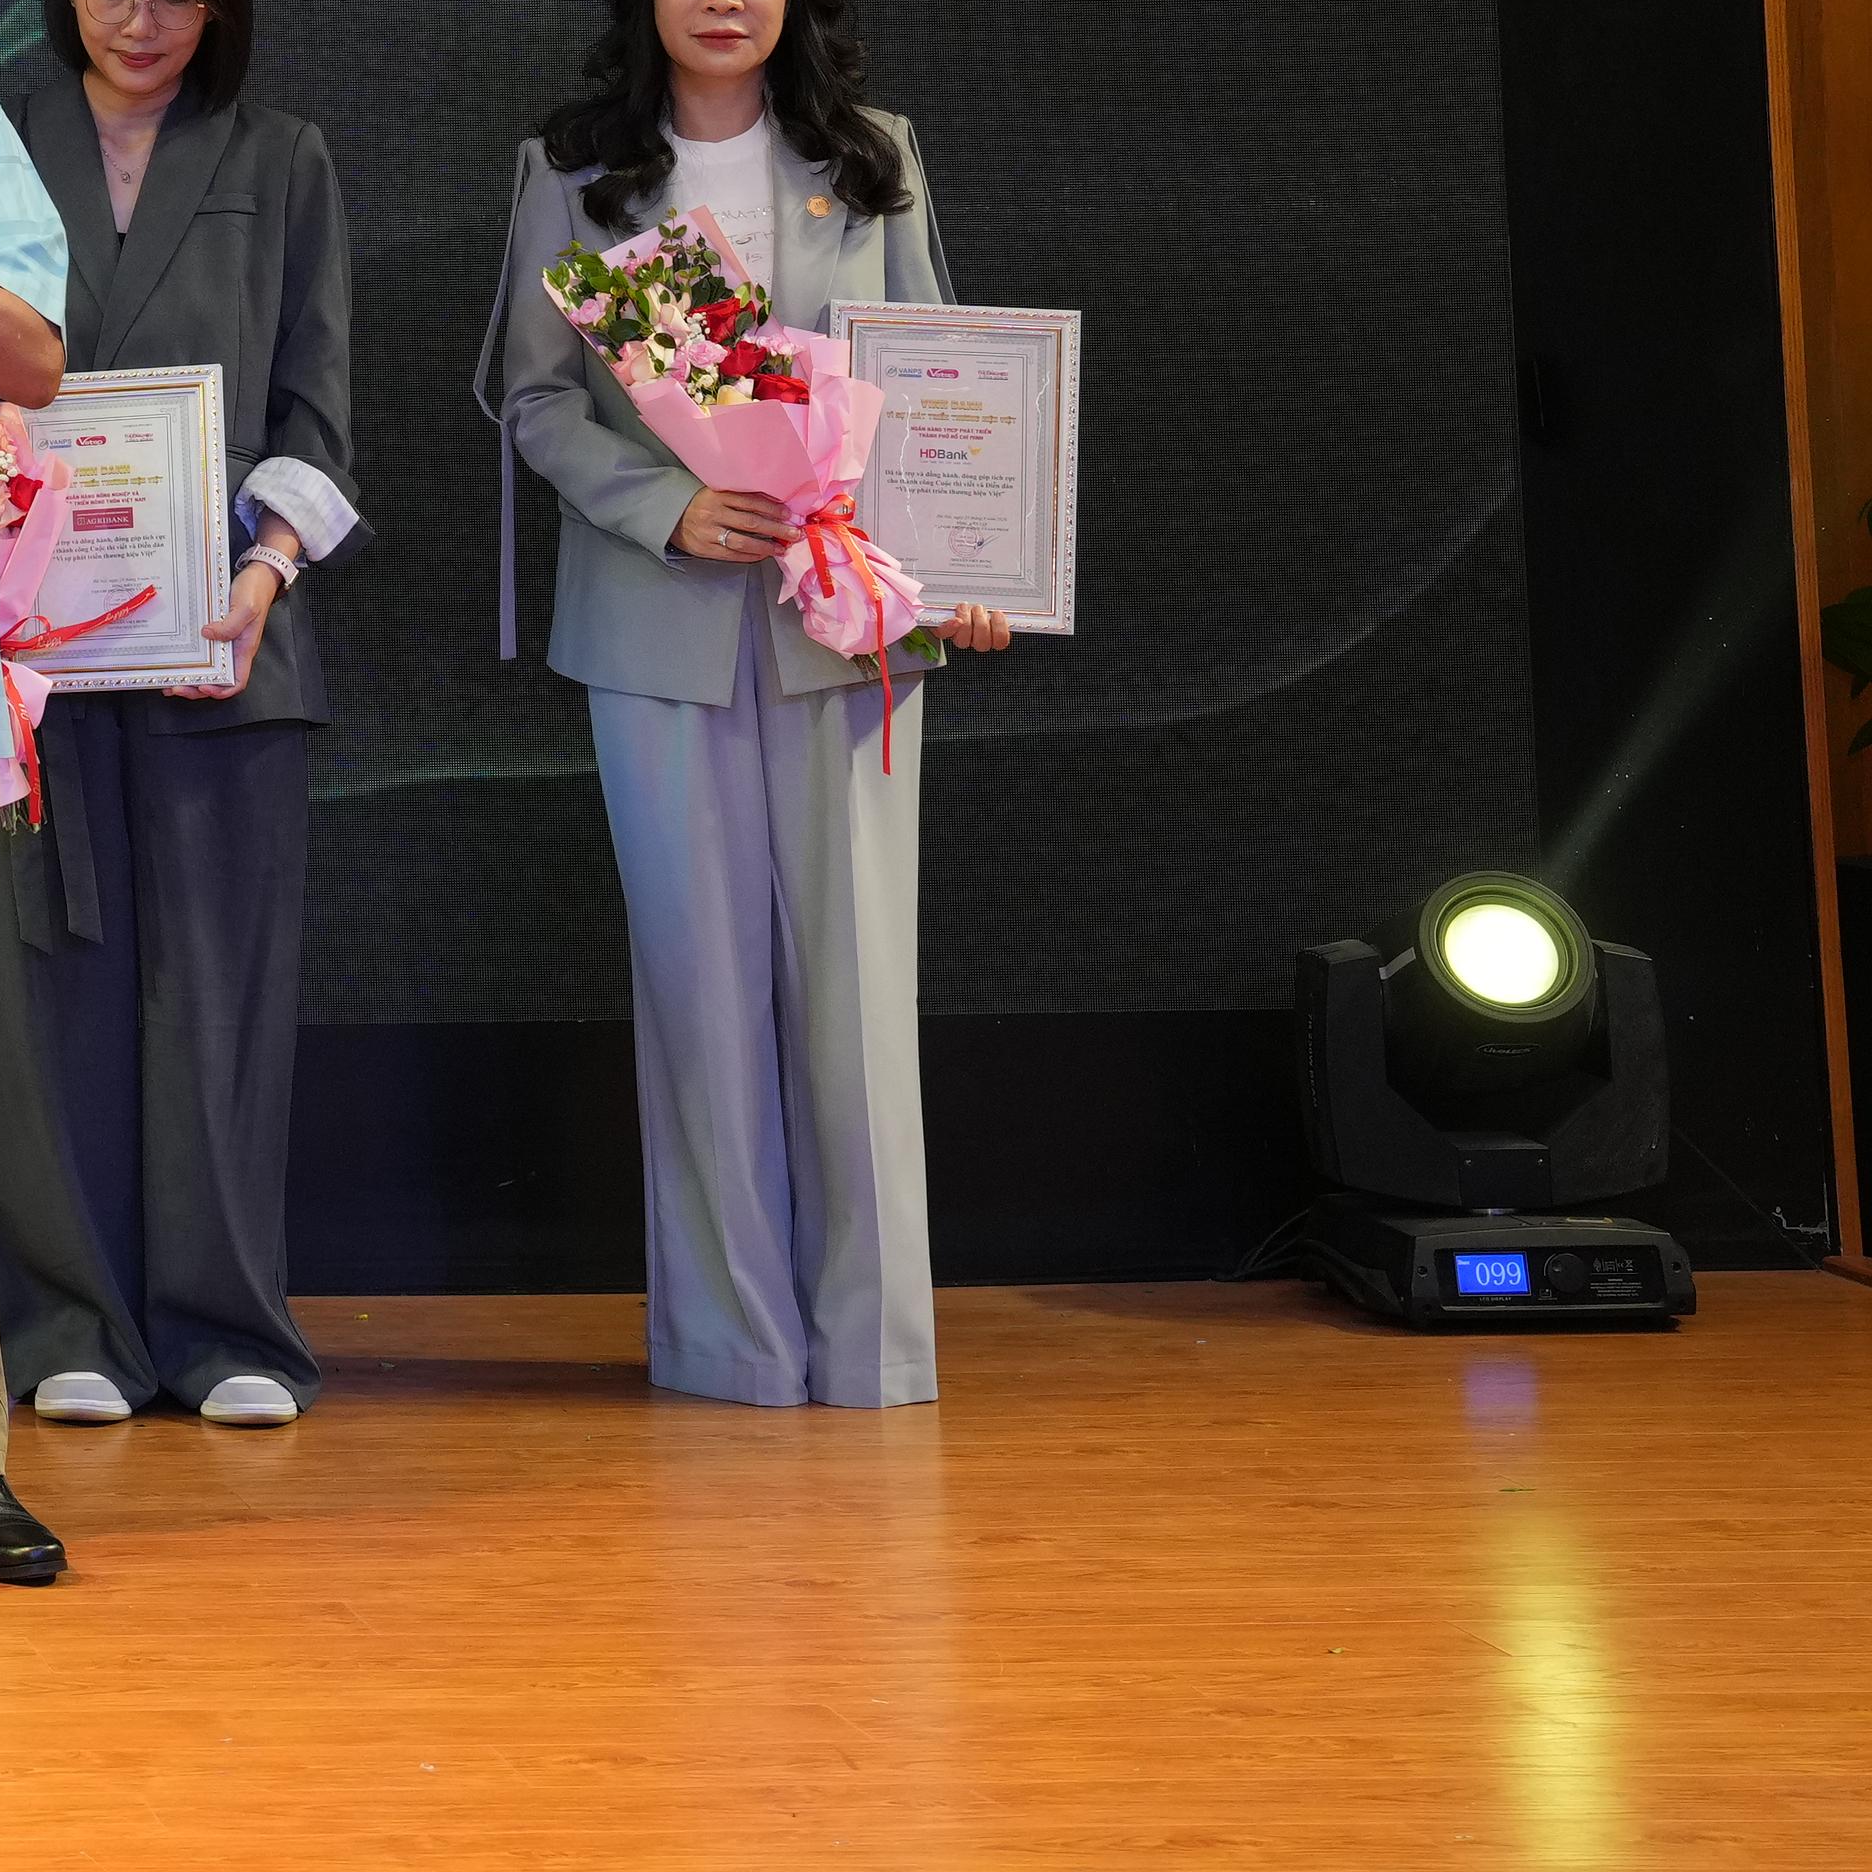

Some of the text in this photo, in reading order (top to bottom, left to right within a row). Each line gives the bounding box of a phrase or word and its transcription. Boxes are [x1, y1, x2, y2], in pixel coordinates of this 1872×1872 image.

[919, 449, 968, 460] HDBank
[86, 516, 129, 525] AGRIBANK
[1475, 1260, 1522, 1287] 099
